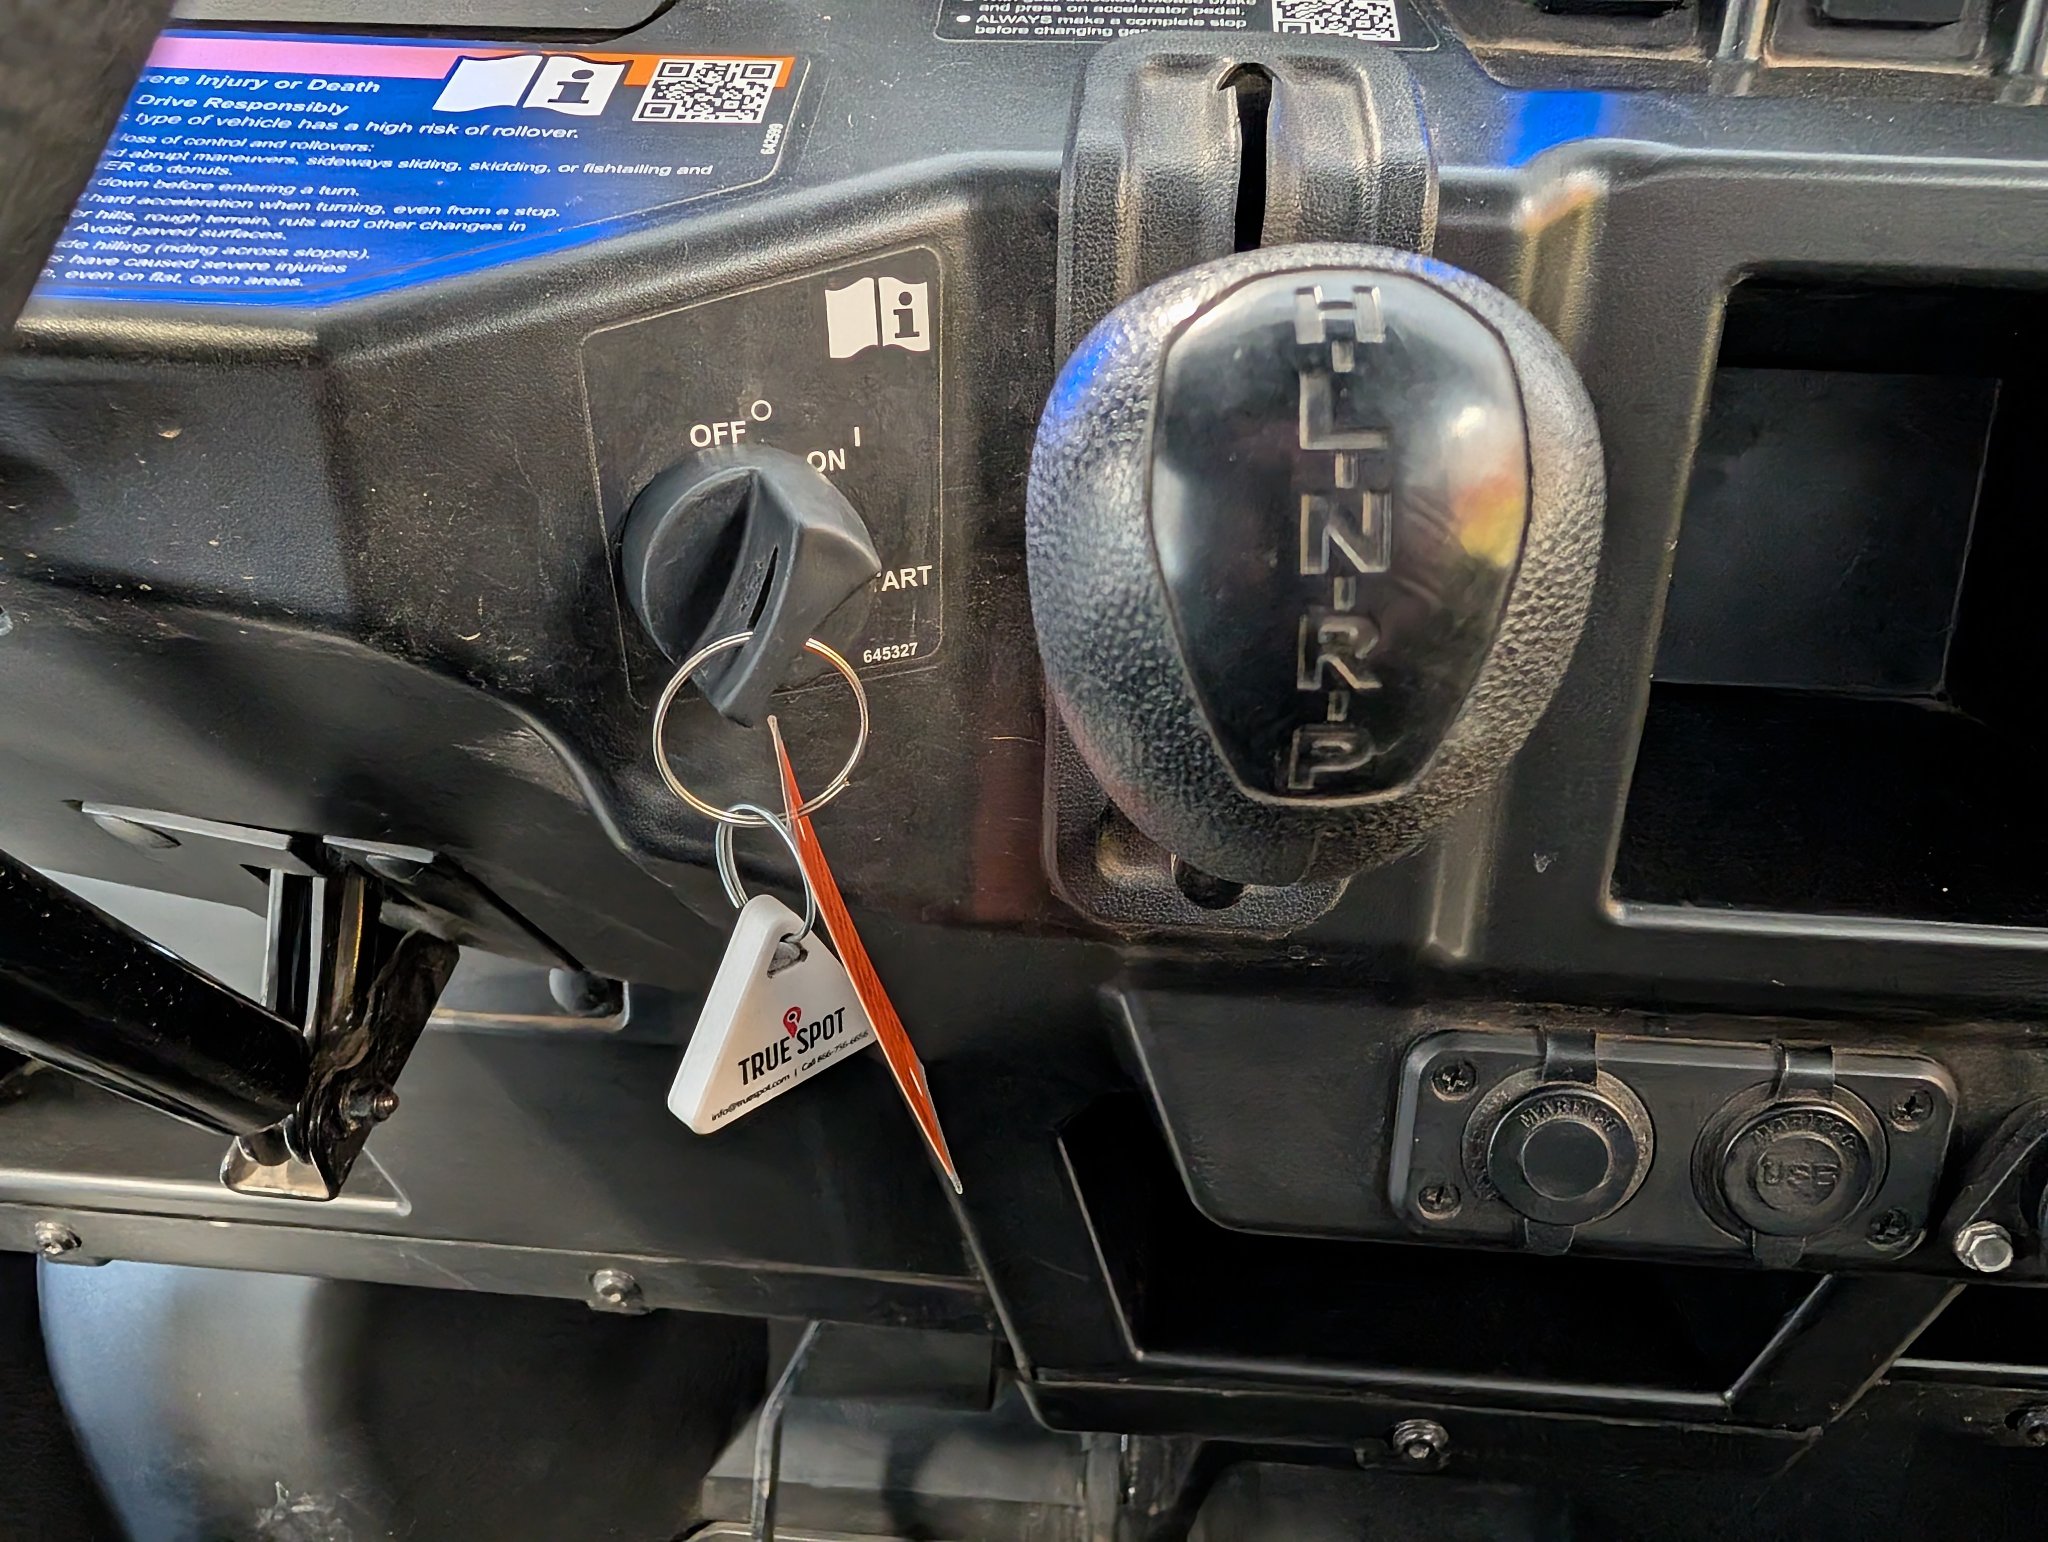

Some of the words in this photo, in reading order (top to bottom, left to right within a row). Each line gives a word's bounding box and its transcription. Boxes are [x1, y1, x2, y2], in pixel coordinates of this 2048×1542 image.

[979, 3, 1010, 12] and
[1014, 5, 1062, 14] press
[1093, 5, 1188, 14] accelerator
[1194, 6, 1246, 16] pedal.
[974, 25, 1030, 34] before
[1034, 26, 1113, 36] changing
[976, 14, 1052, 24] ALWAYS
[1058, 16, 1105, 24] make
[1126, 18, 1205, 27] complete
[1210, 18, 1247, 29] stop
[196, 74, 269, 90] Injury
[274, 79, 303, 90] or
[307, 78, 380, 93] Death
[136, 94, 198, 108] Drive
[203, 96, 350, 116] Responsibly
[136, 112, 182, 126] type
[188, 114, 214, 126] of
[216, 116, 292, 129] vehicle
[298, 118, 338, 130] has
[344, 122, 360, 131] a
[365, 121, 413, 135] high
[419, 123, 460, 135] risk
[464, 124, 490, 136] of
[492, 126, 578, 138] rollover.
[120, 132, 158, 144] loss
[161, 135, 183, 144] of
[184, 136, 248, 147] control
[250, 140, 288, 149] and
[129, 148, 190, 161] abrupt
[306, 155, 394, 170] sideways
[558, 164, 580, 173] or
[583, 163, 672, 176] fishtailing
[676, 164, 714, 176] and
[138, 162, 162, 172] do
[166, 164, 232, 176] donuts.
[98, 176, 150, 188] down
[154, 179, 214, 191] before
[218, 182, 296, 196] entering
[300, 186, 314, 195] a
[137, 196, 254, 209] acceleration
[260, 200, 311, 211] when
[394, 205, 442, 215] even
[447, 204, 491, 216] from
[496, 208, 510, 216] a
[514, 206, 560, 218] stop.
[71, 209, 94, 218] or
[144, 212, 201, 224] rough
[278, 216, 316, 227] ruts
[320, 218, 360, 228] and
[364, 219, 416, 230] other
[419, 220, 503, 233] changes
[508, 221, 526, 232] in
[73, 222, 133, 234] Avoid
[69, 254, 120, 266] have
[124, 258, 200, 269] caused
[202, 260, 270, 270] severe
[222, 246, 289, 257] across
[118, 272, 145, 282] on
[190, 274, 240, 286] open
[1294, 285, 1386, 344] H
[1299, 372, 1392, 451] L
[690, 420, 746, 448] OFF
[807, 448, 846, 474] ON
[1300, 490, 1392, 576] N
[874, 565, 932, 592] ART
[863, 642, 918, 664] 645327
[1297, 611, 1383, 691] R
[1288, 723, 1378, 790] P
[738, 1036, 792, 1086] TRUE
[797, 1006, 846, 1055] SPOT
[802, 1058, 816, 1072] Call
